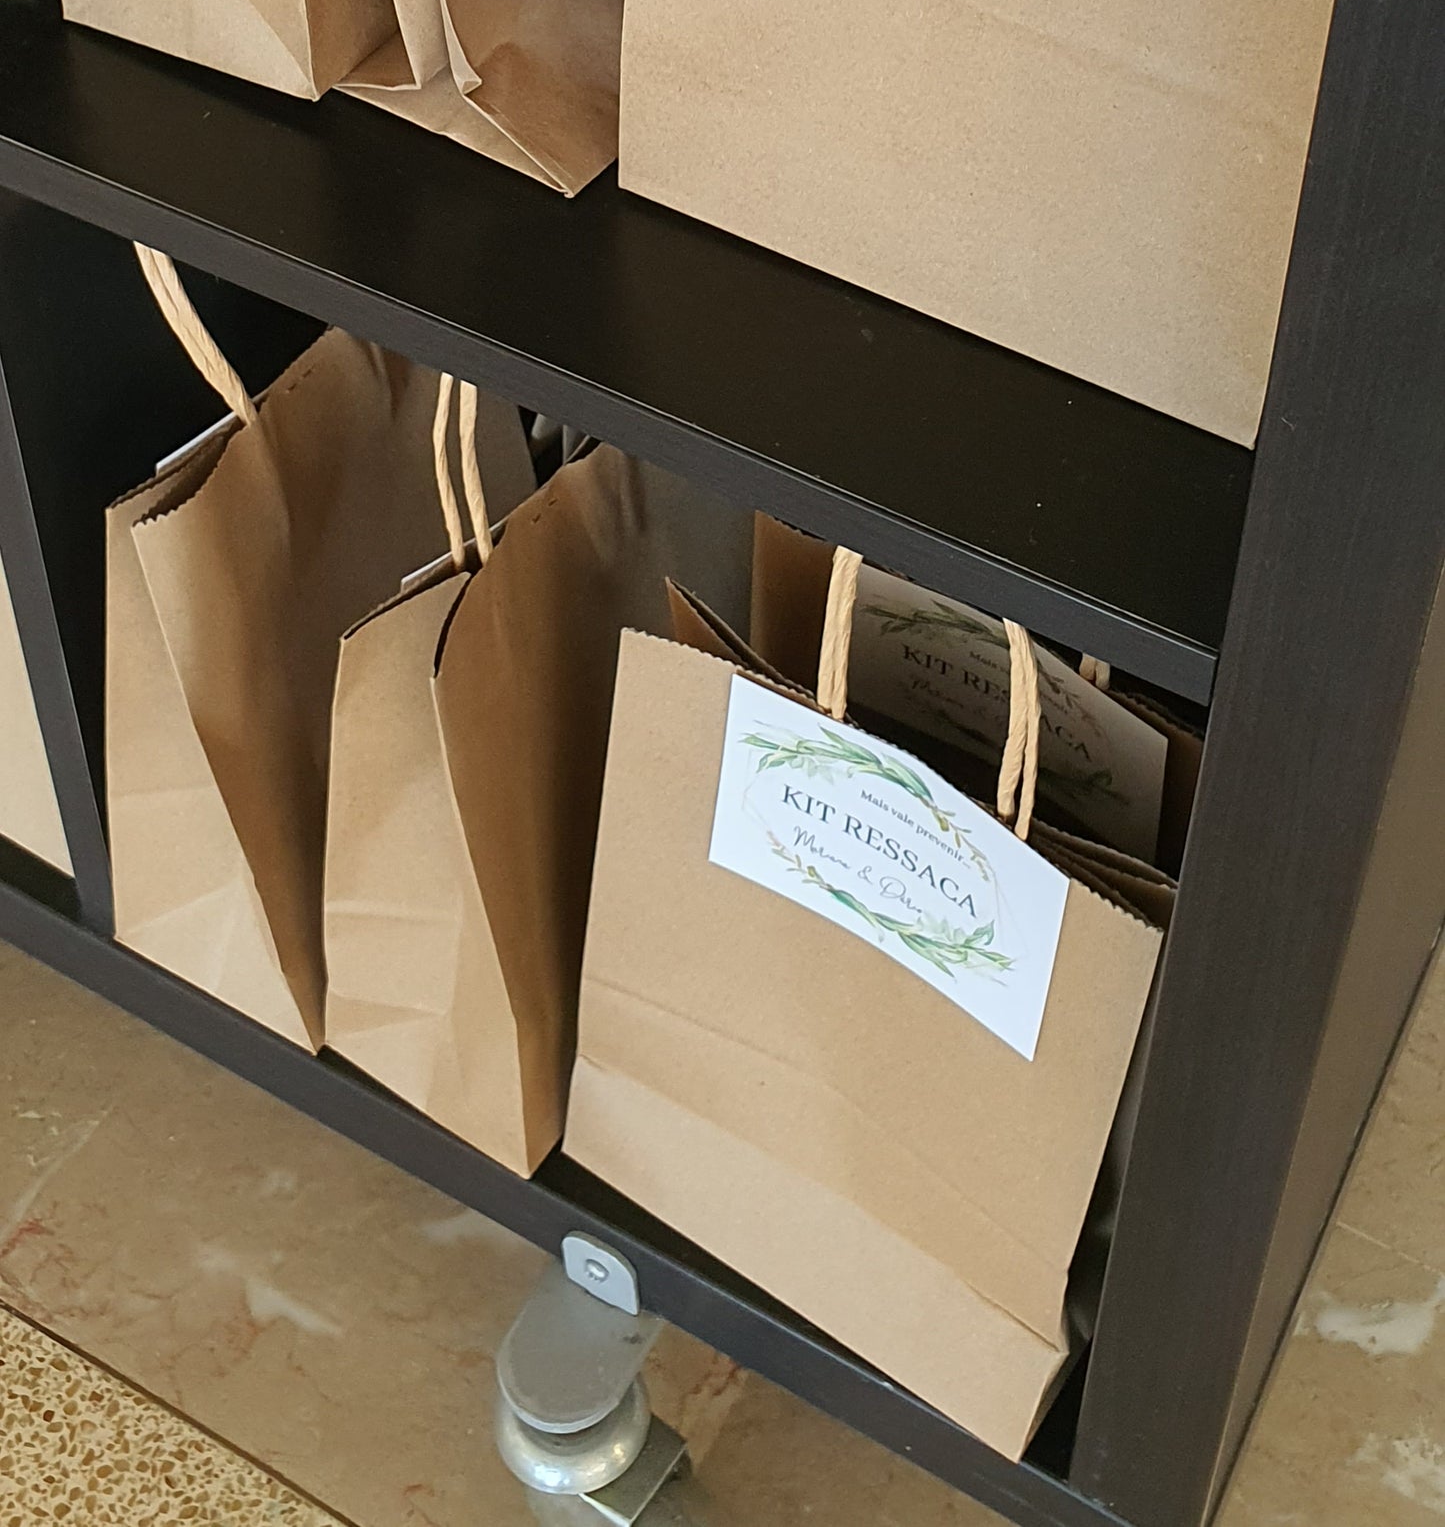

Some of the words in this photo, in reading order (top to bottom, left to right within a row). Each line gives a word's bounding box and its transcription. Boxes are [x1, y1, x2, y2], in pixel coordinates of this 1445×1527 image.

[902, 644, 953, 675] KIT
[860, 789, 889, 812] Mais
[891, 808, 915, 828] vale
[781, 784, 836, 824] KIT
[842, 813, 977, 919] RESSACA
[857, 865, 874, 885] &
